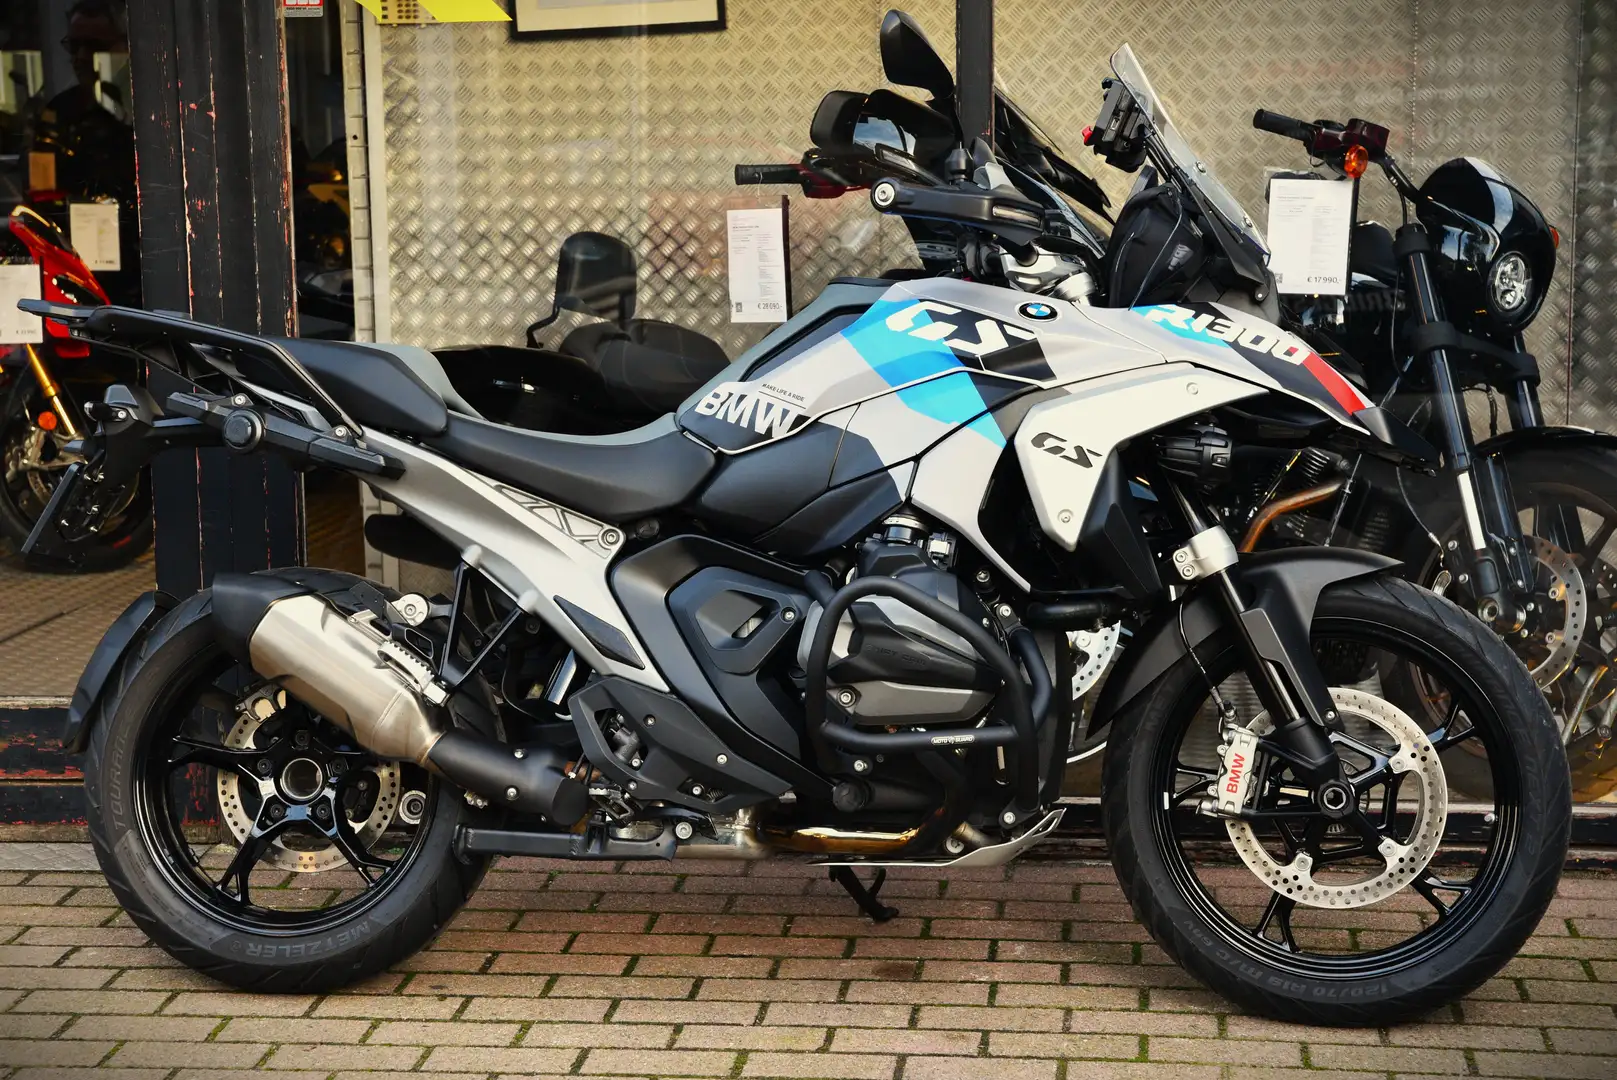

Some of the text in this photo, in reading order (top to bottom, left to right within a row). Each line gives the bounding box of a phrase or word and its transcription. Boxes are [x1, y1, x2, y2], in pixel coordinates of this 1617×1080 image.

[885, 301, 1038, 356] GS
[694, 388, 801, 439] BMW
[761, 383, 777, 392] MAKE
[776, 388, 787, 396] LIFE
[792, 393, 805, 402] RIDE
[1030, 431, 1103, 469] GS
[109, 704, 136, 831] TOURANCE
[1225, 752, 1246, 794] BMW
[245, 920, 371, 958] METZELER
